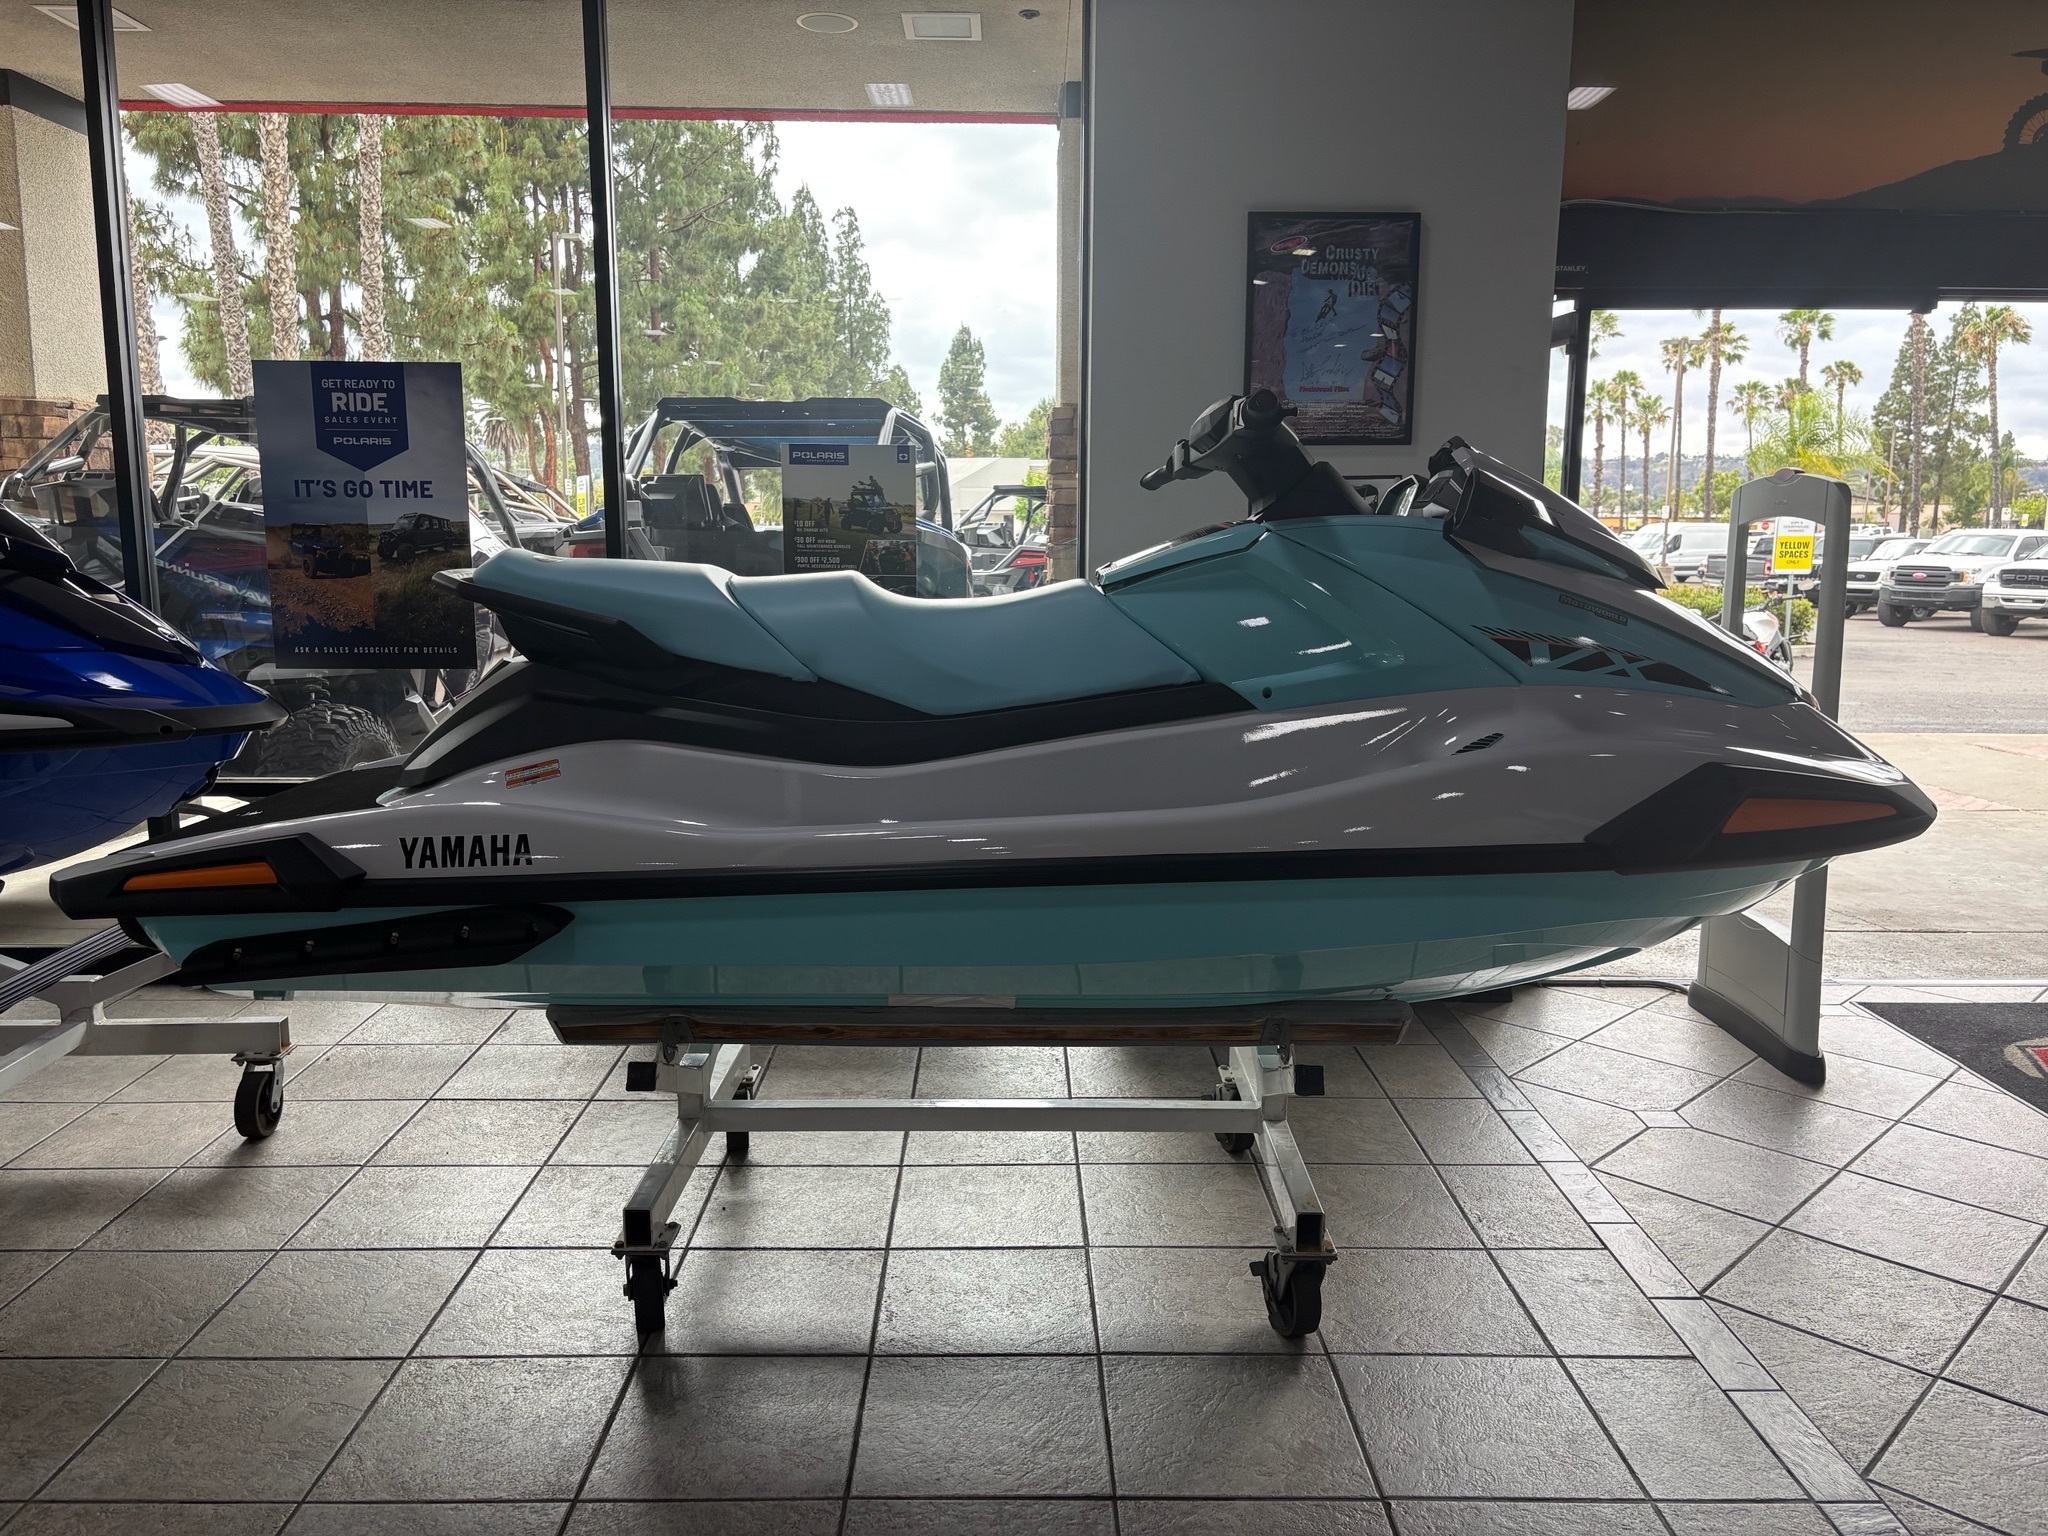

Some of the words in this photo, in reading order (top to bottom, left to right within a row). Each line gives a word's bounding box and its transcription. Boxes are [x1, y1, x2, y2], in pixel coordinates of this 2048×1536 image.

[1301, 258, 1356, 275] DEMONS
[322, 379, 343, 389] GET
[345, 379, 379, 389] READY
[382, 379, 395, 389] TO
[332, 392, 388, 413] RIDE
[324, 416, 359, 424] SALES
[364, 416, 398, 424] EVENT
[333, 436, 392, 445] POLARIS
[792, 452, 845, 460] POLARIS
[294, 479, 337, 498] IT'S
[344, 480, 374, 498] GO
[380, 480, 433, 498] TIME
[1779, 550, 1808, 558] SPACES
[294, 646, 310, 654] ASK
[314, 646, 320, 654] A
[323, 646, 350, 654] SALES
[354, 646, 399, 654] ASSOCIATE
[403, 646, 419, 654] FOR
[423, 646, 458, 654] DETAILS
[399, 834, 533, 869] YAMAHA
